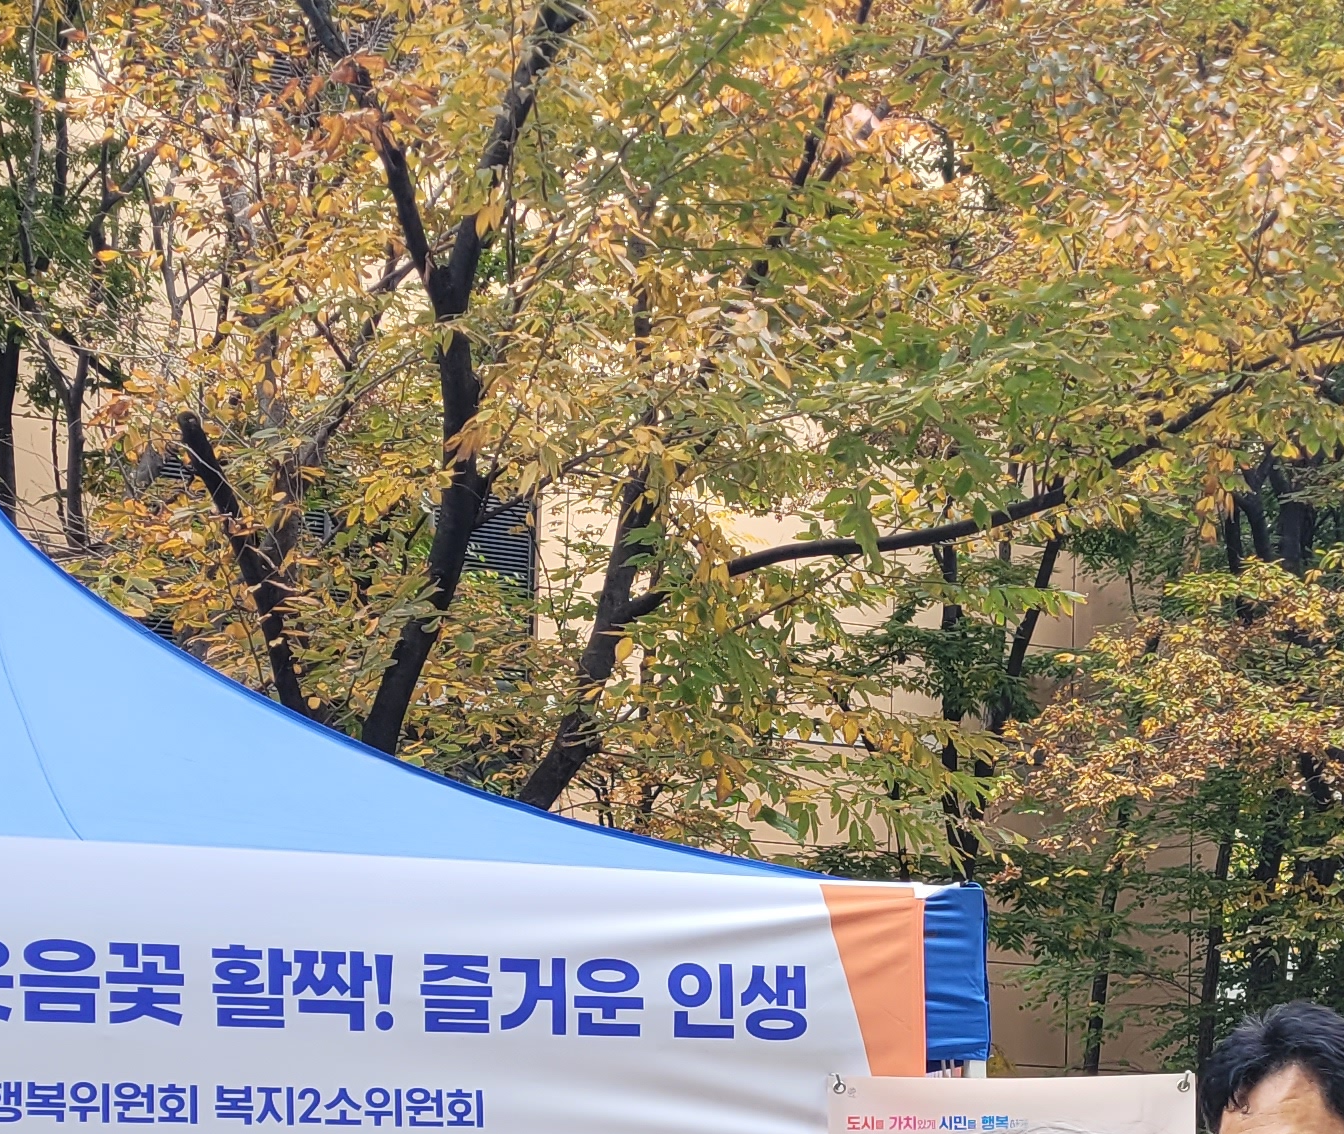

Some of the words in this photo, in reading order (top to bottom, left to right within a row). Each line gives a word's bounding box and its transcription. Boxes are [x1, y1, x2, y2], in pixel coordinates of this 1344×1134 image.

[211, 943, 396, 1033] 활짝!
[419, 952, 645, 1038] 즐거운
[666, 961, 809, 1041] 인생
[213, 1083, 486, 1130] 복지2소위원회
[888, 1115, 937, 1131] 가치있게
